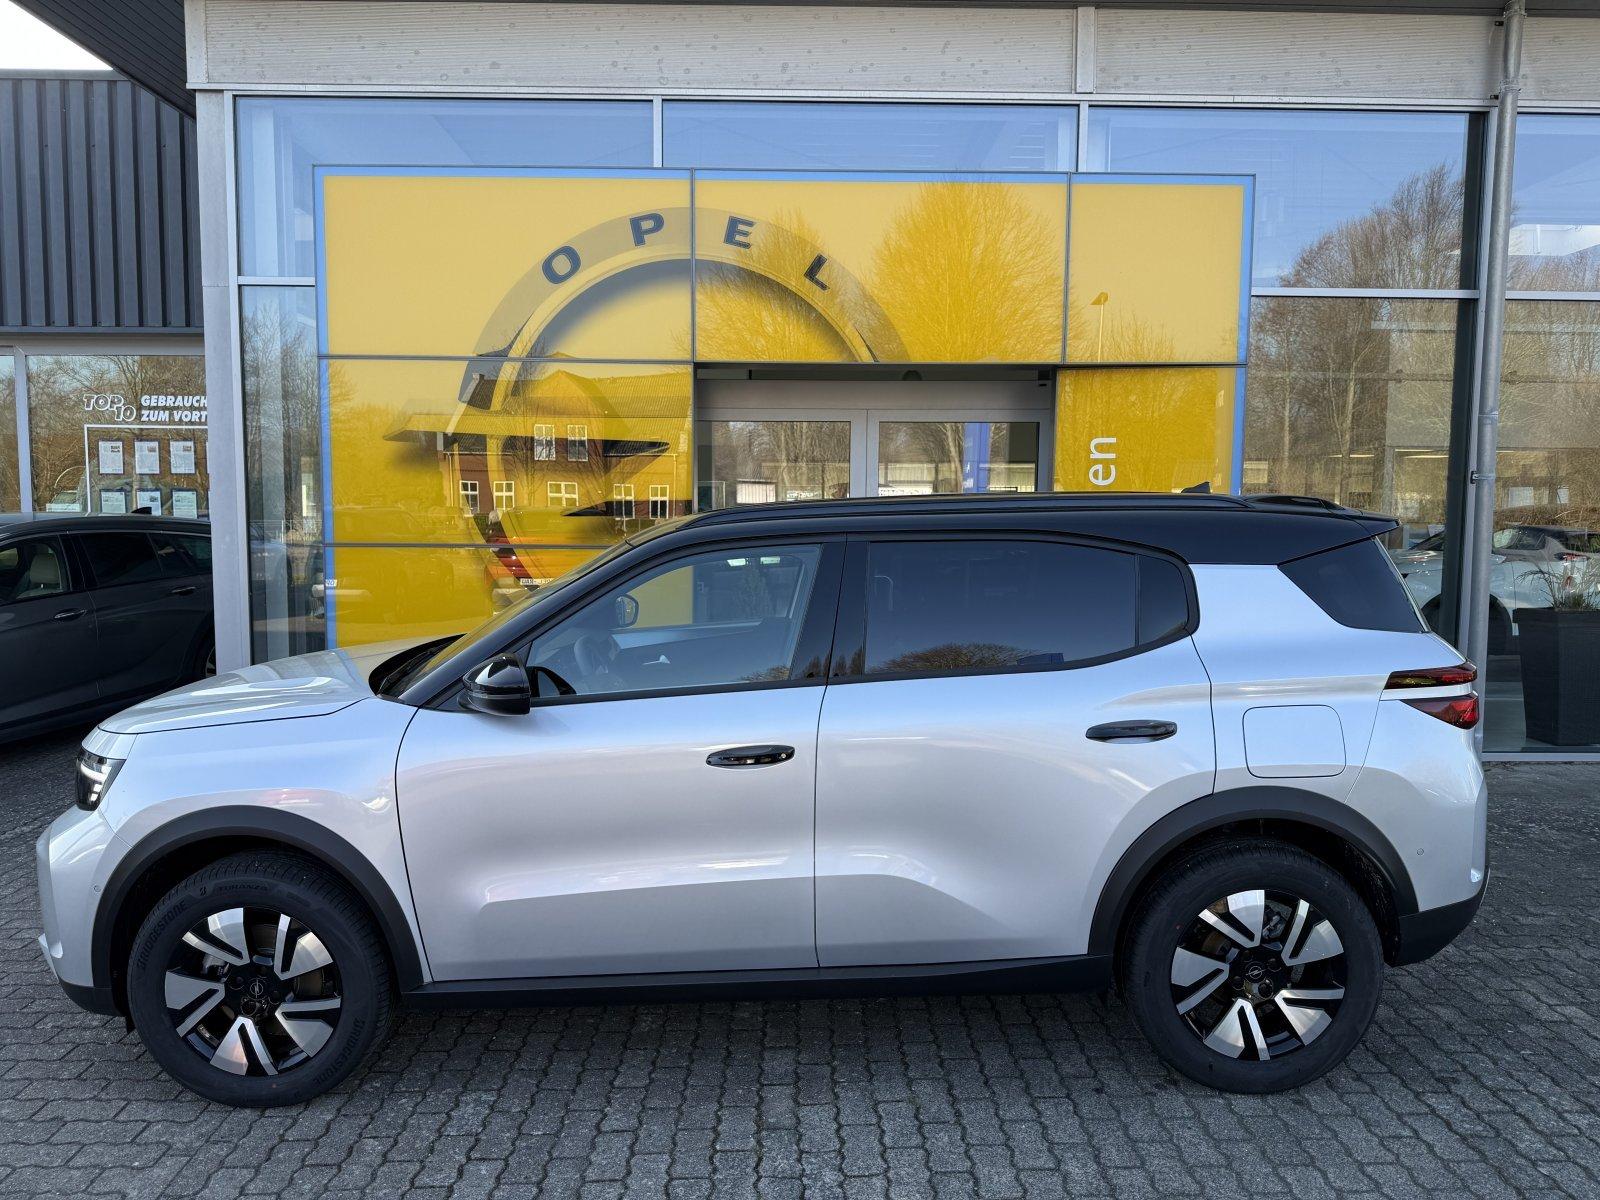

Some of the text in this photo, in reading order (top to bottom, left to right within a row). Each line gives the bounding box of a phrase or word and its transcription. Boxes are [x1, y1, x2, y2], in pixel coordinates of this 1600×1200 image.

[541, 212, 830, 290] OPEL
[83, 394, 124, 410] TOP
[114, 406, 137, 421] 10
[141, 410, 170, 422] ZUM
[1089, 437, 1117, 486] en
[137, 899, 188, 970] BRIDGESTONE
